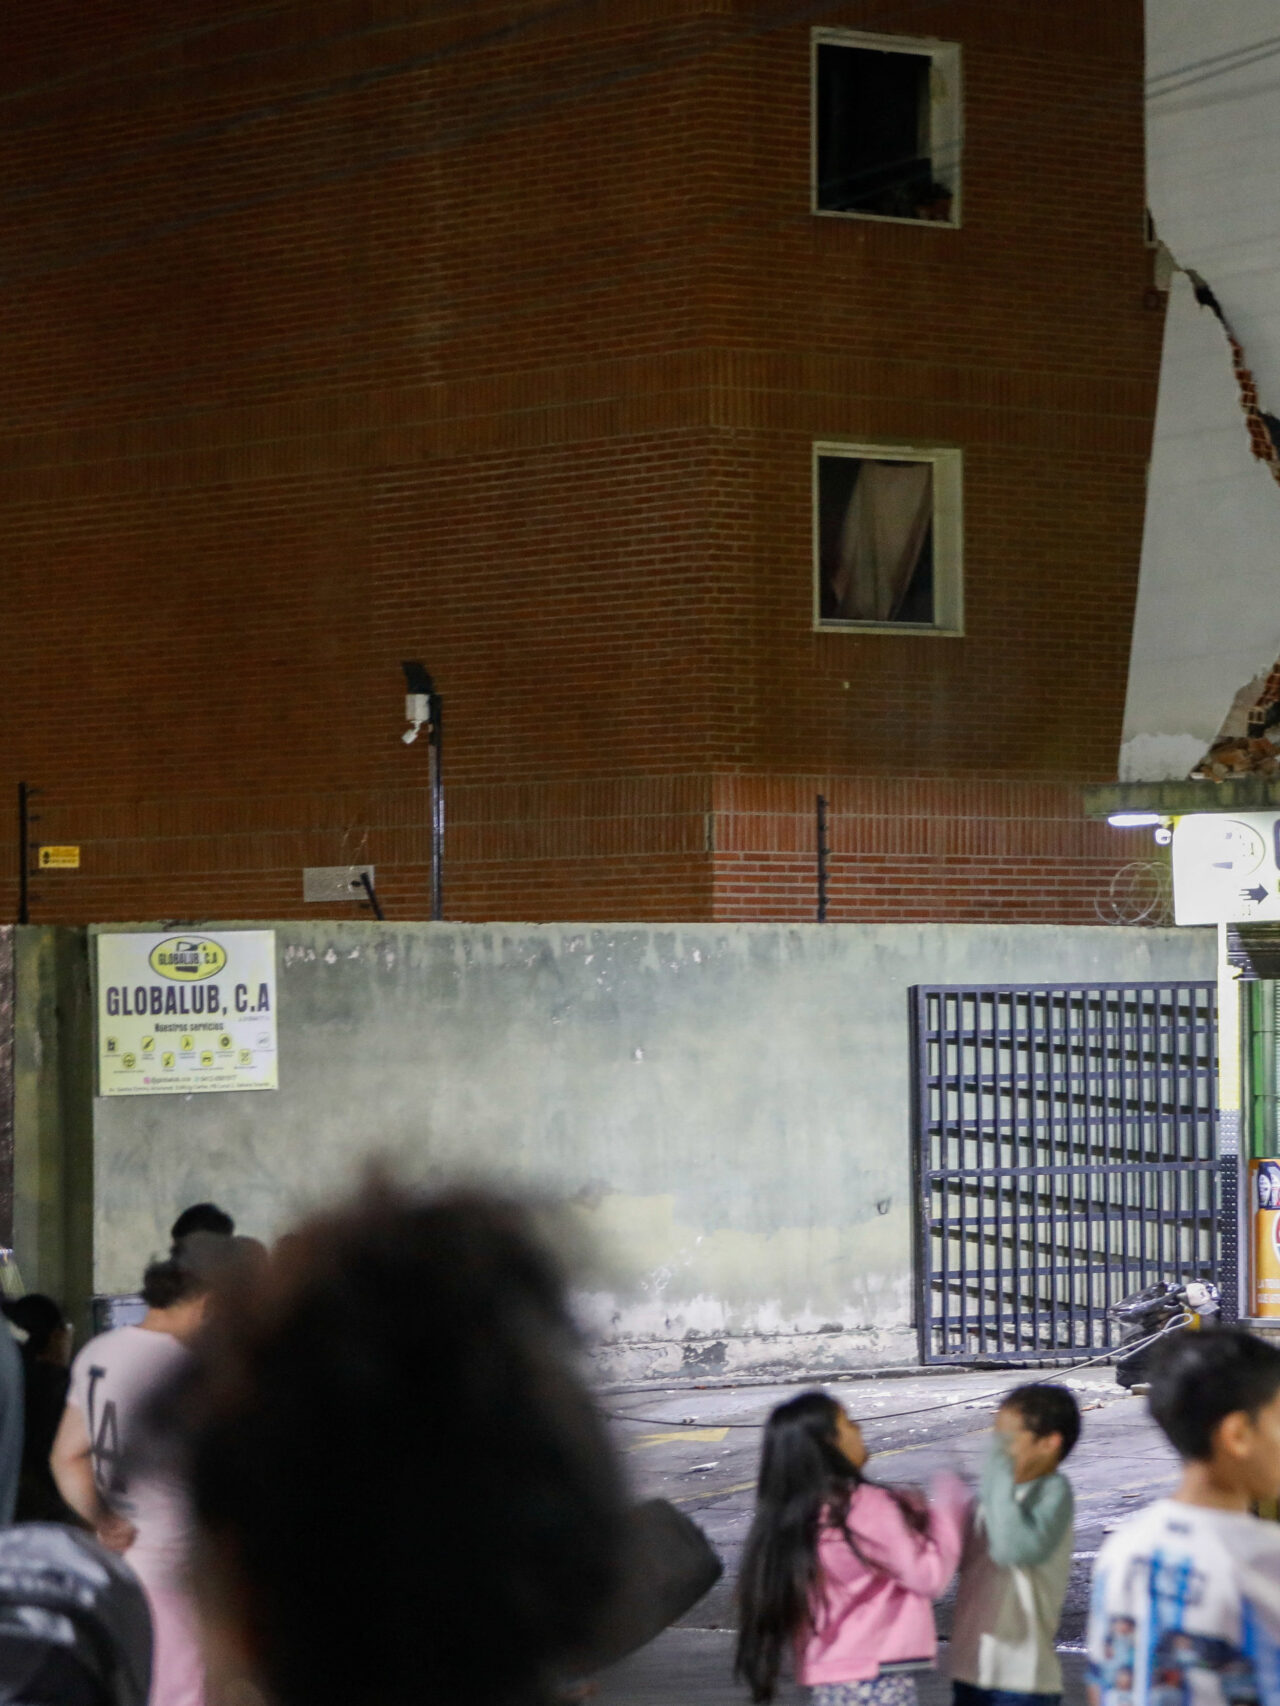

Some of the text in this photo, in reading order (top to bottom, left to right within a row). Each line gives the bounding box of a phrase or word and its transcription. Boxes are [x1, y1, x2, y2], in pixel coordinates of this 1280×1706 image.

[106, 982, 271, 1017] GLOBALUB, C.A
[154, 1022, 224, 1033] Nuestros servicios
